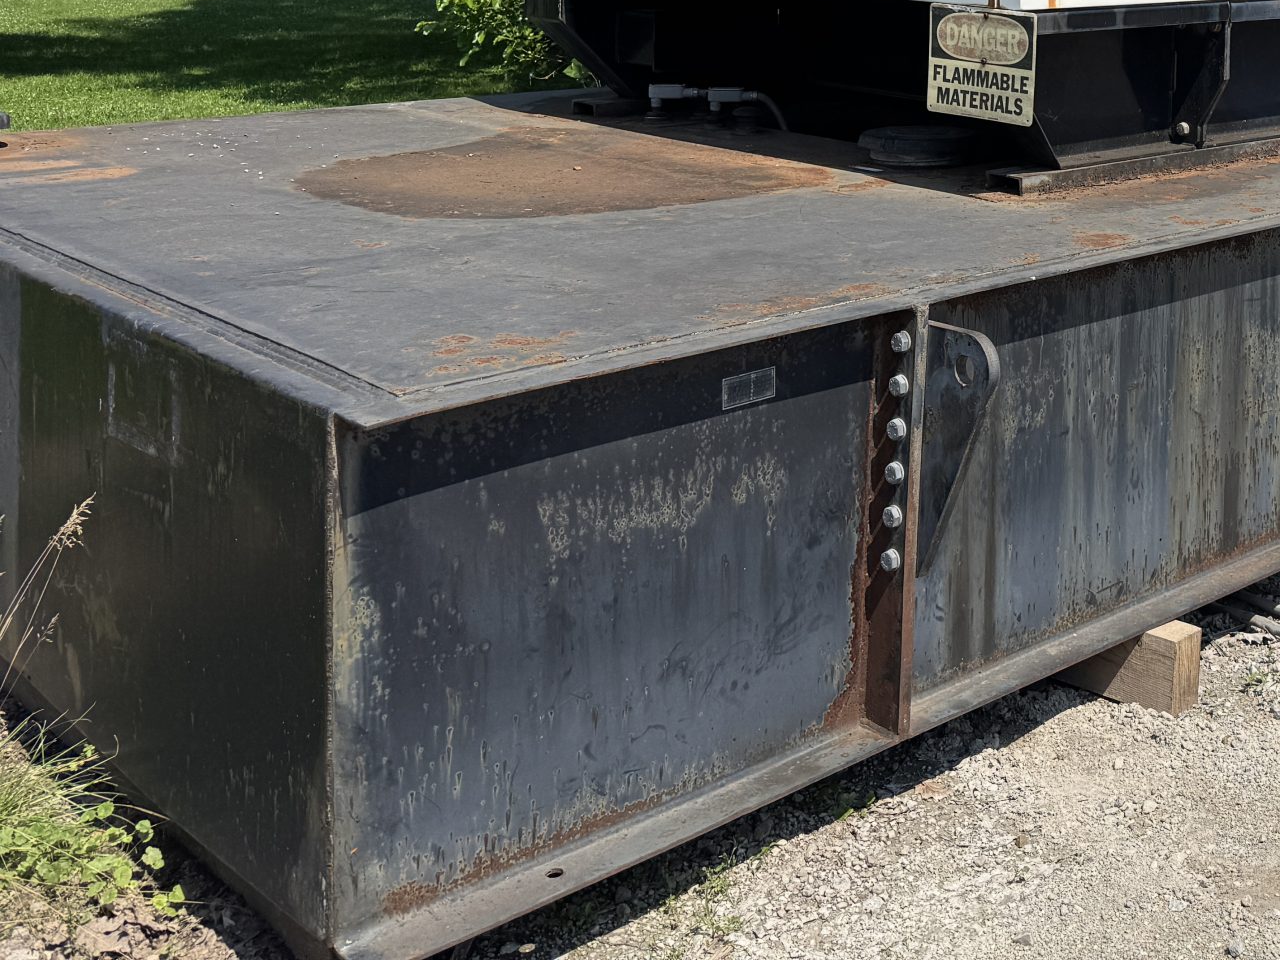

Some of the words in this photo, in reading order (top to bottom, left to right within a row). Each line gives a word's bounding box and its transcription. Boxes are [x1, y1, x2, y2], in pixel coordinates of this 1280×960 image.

[946, 22, 1020, 55] DANGER
[933, 64, 1029, 94] FLAMMABLE
[936, 86, 1023, 116] MATERIALS
